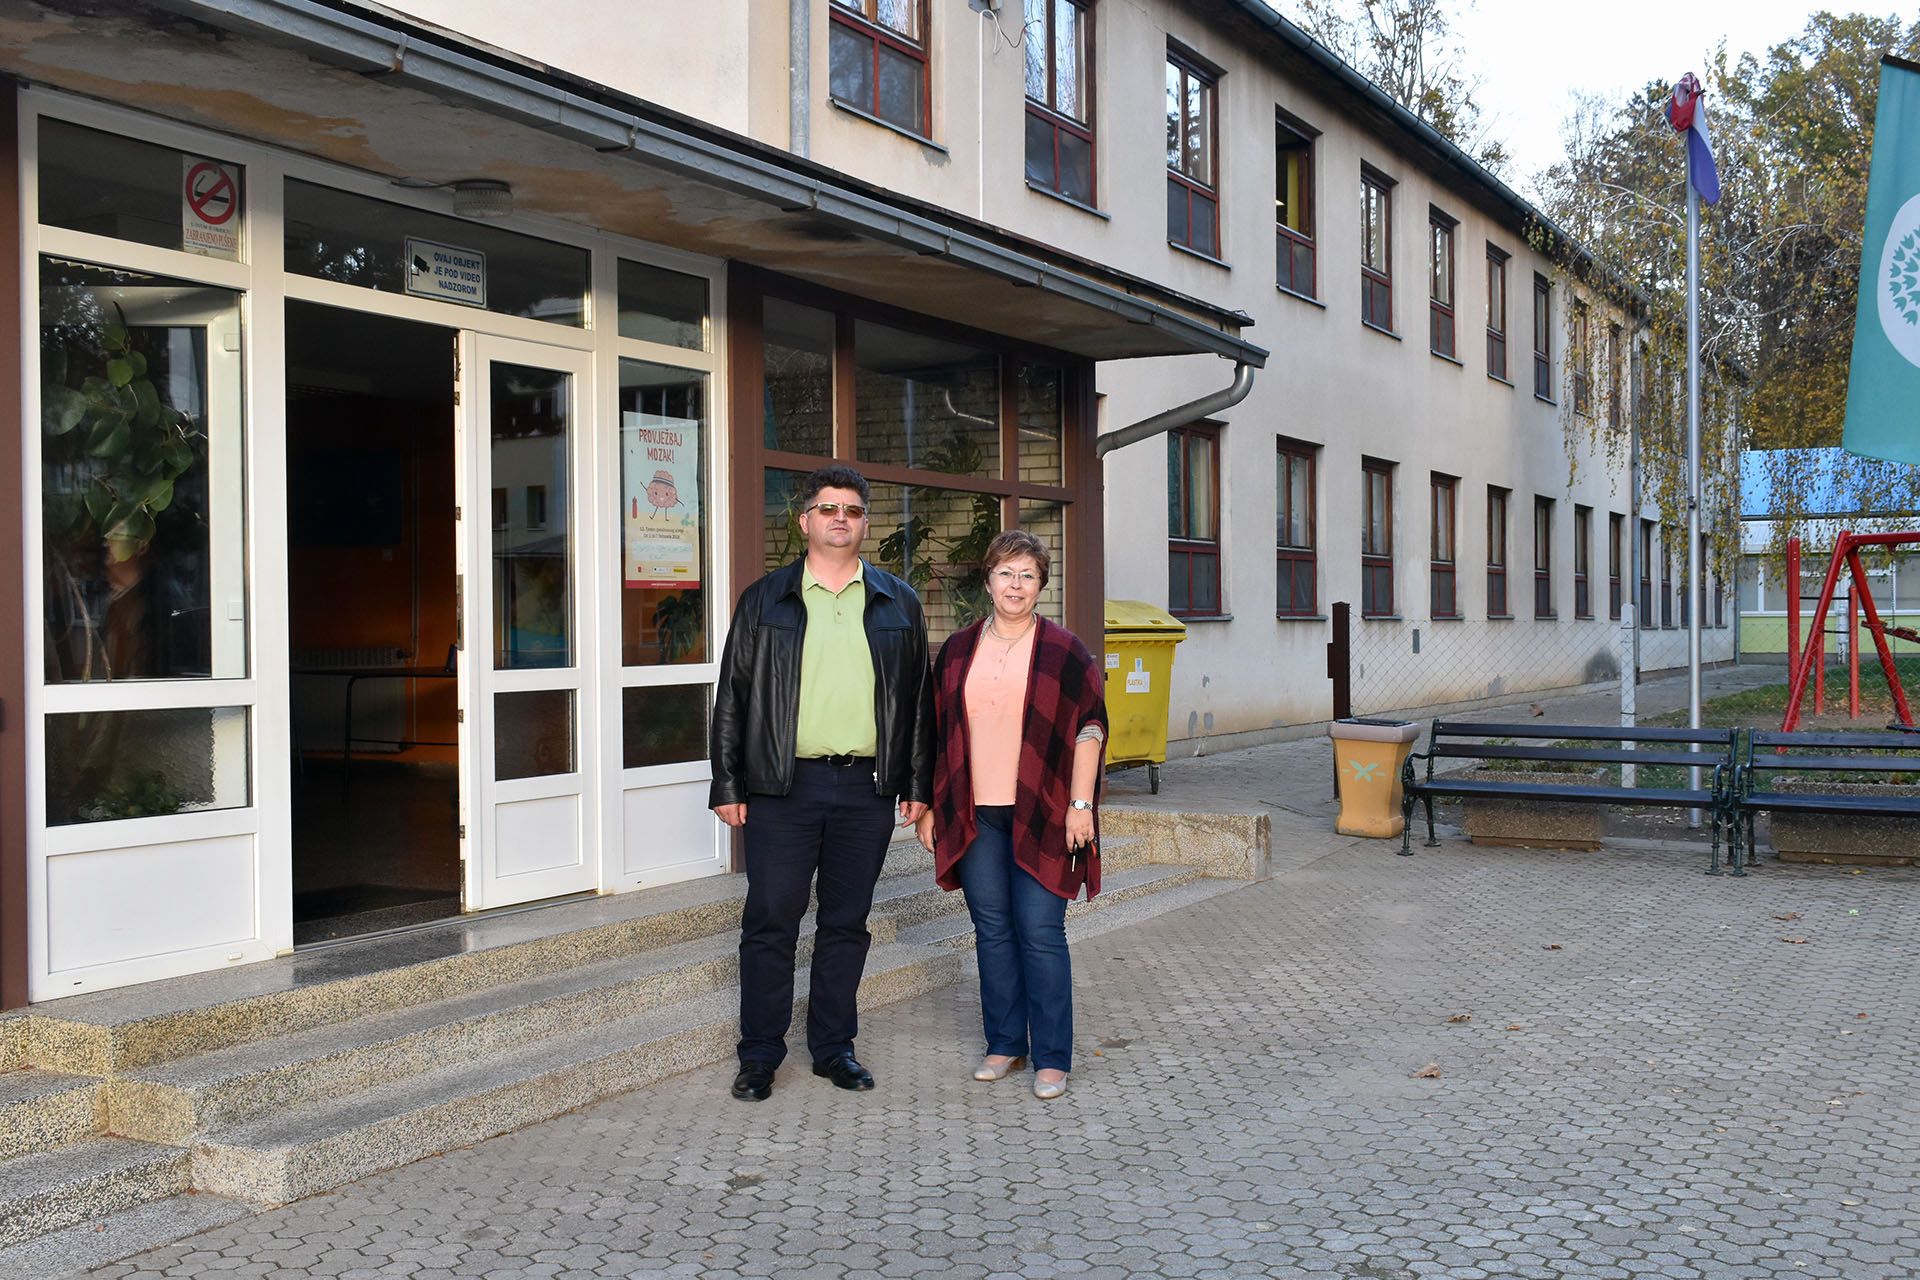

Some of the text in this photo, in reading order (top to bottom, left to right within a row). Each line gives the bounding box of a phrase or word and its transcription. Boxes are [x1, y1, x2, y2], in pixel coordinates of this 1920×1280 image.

[434, 252, 480, 270] OVAJ OBJEKT
[434, 266, 481, 283] JE POD VIDEO
[438, 280, 477, 295] NADZOROM
[639, 428, 683, 447] PROVJEŽBAJ
[647, 447, 675, 464] MOZAK!
